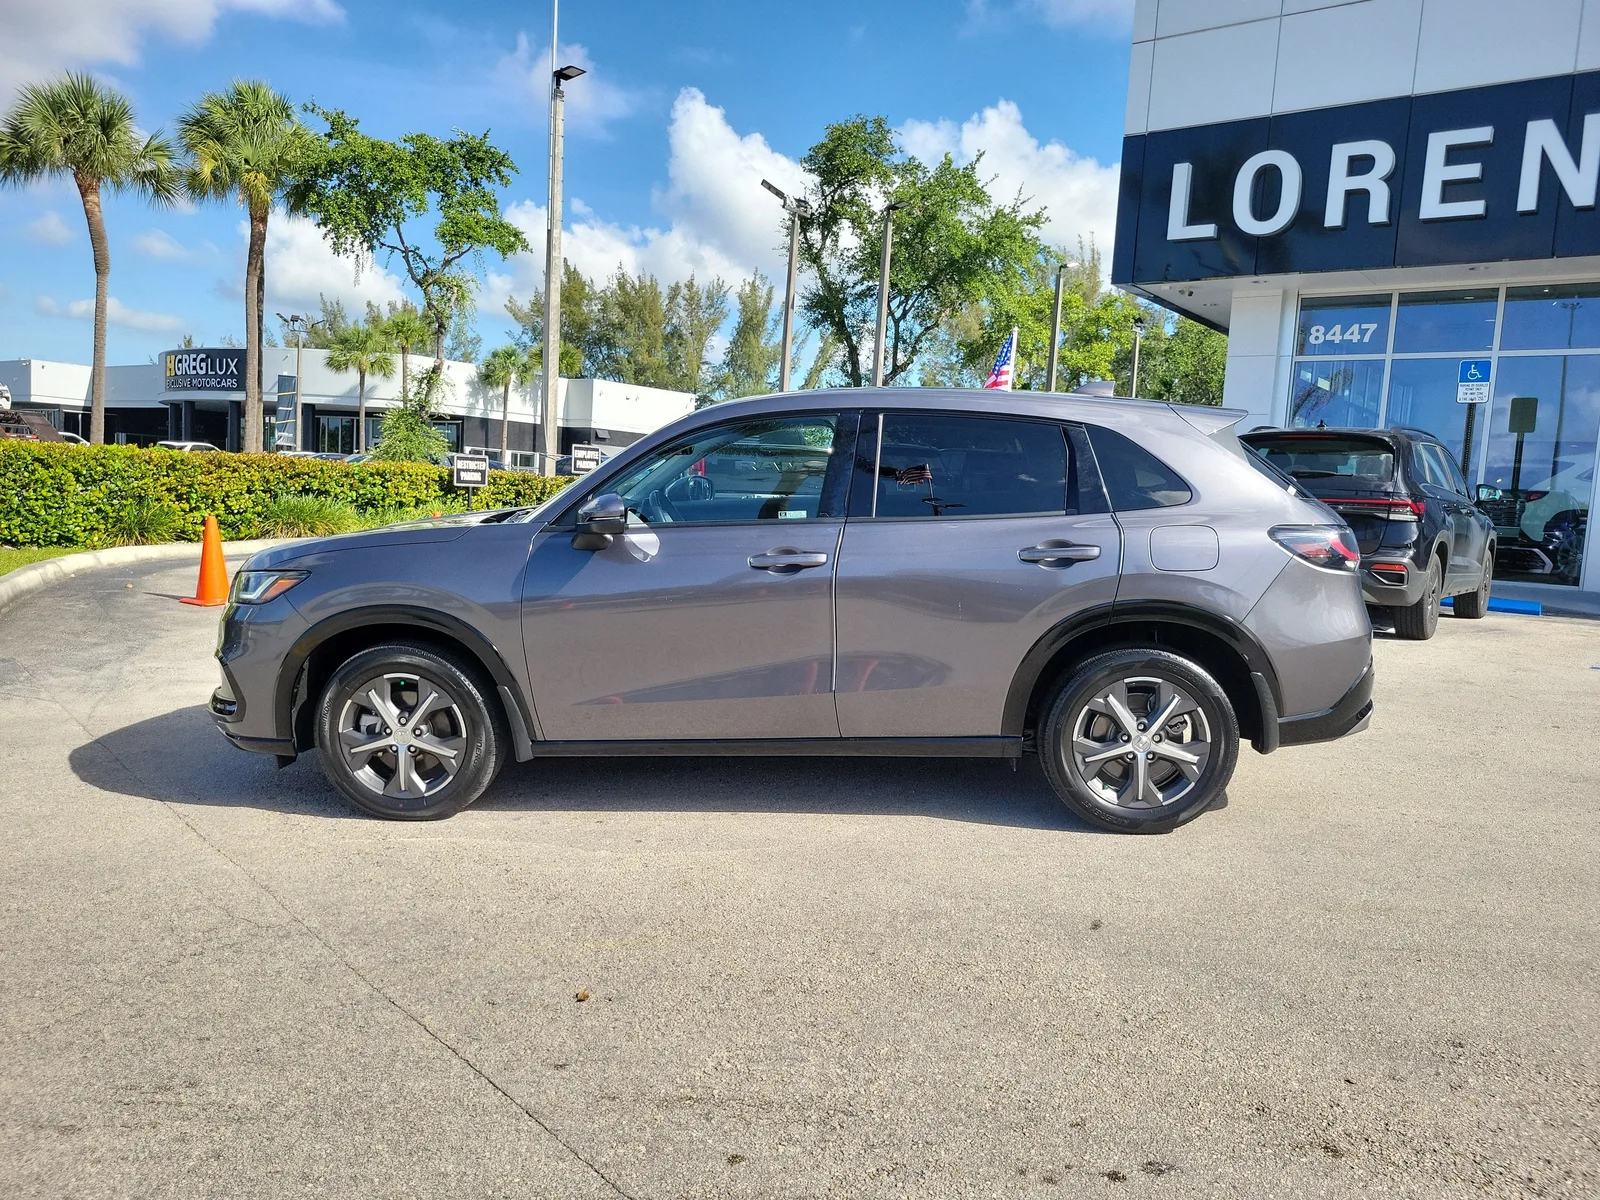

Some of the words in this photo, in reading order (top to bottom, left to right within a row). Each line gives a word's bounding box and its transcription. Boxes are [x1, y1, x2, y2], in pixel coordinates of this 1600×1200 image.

[1166, 112, 1600, 242] LOREN
[1309, 323, 1378, 345] 8447
[192, 378, 238, 388] MOTORCARS
